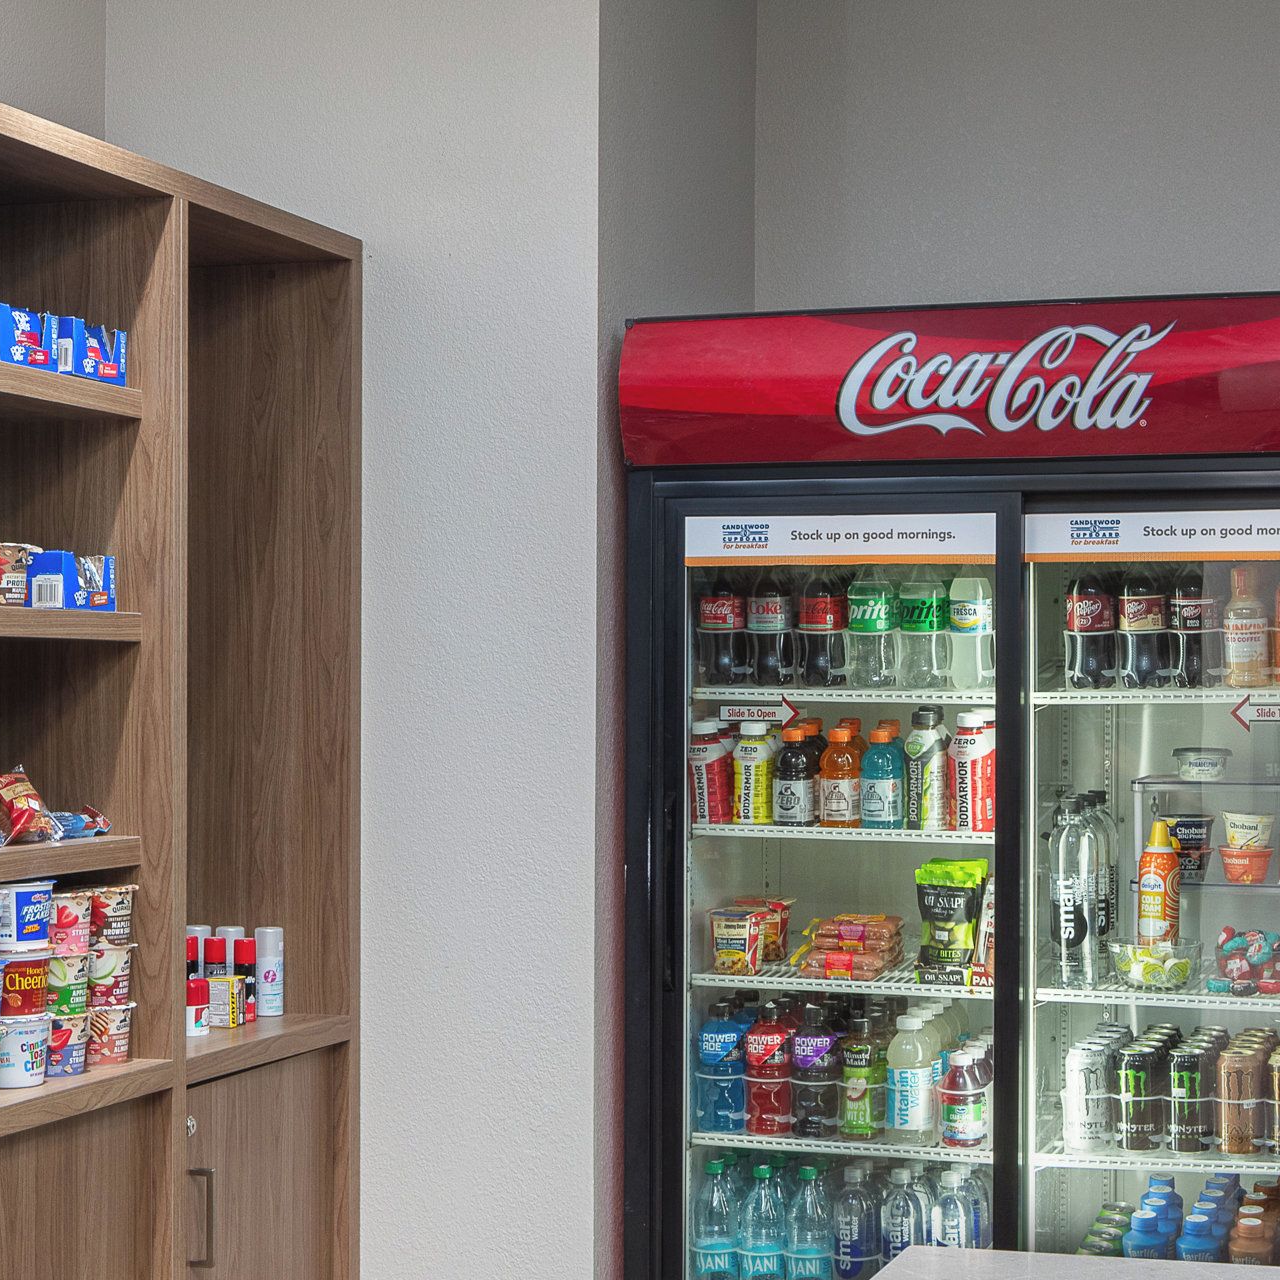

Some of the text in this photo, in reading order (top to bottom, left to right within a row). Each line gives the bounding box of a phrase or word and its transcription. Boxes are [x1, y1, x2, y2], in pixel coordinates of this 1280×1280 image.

[835, 320, 1177, 437] Coca-Cola
[790, 529, 956, 543] Stock up on good mornings.
[1143, 526, 1177, 537] Stock
[1181, 528, 1197, 540] up
[1200, 528, 1216, 537] on
[1220, 525, 1253, 538] good
[1084, 538, 1119, 546] breakfast
[749, 600, 782, 615] Coke
[952, 607, 978, 616] FRESCA
[727, 708, 777, 720] Slide To Open
[1256, 708, 1275, 718] Slide
[953, 738, 976, 746] ZERO
[695, 764, 706, 819] BODYARMOR
[743, 764, 752, 820] BODYARMOR
[909, 760, 918, 822] BODYARMOR
[959, 760, 968, 827] BODYARMOR
[1177, 826, 1207, 835] Chobani
[1229, 821, 1259, 831] Chobani
[1141, 882, 1162, 891] delight
[703, 1033, 737, 1044] POWER
[748, 1035, 781, 1045] POWER
[795, 1037, 830, 1048] POWER
[703, 1042, 721, 1051] ADE
[748, 1044, 765, 1053] ADE
[795, 1046, 813, 1055] ADE
[843, 1051, 869, 1060] Minute
[846, 1058, 866, 1066] Maid
[910, 1070, 920, 1109] water
[897, 1070, 909, 1127] vitamin
[902, 1217, 910, 1243] water
[839, 1214, 853, 1270] smart
